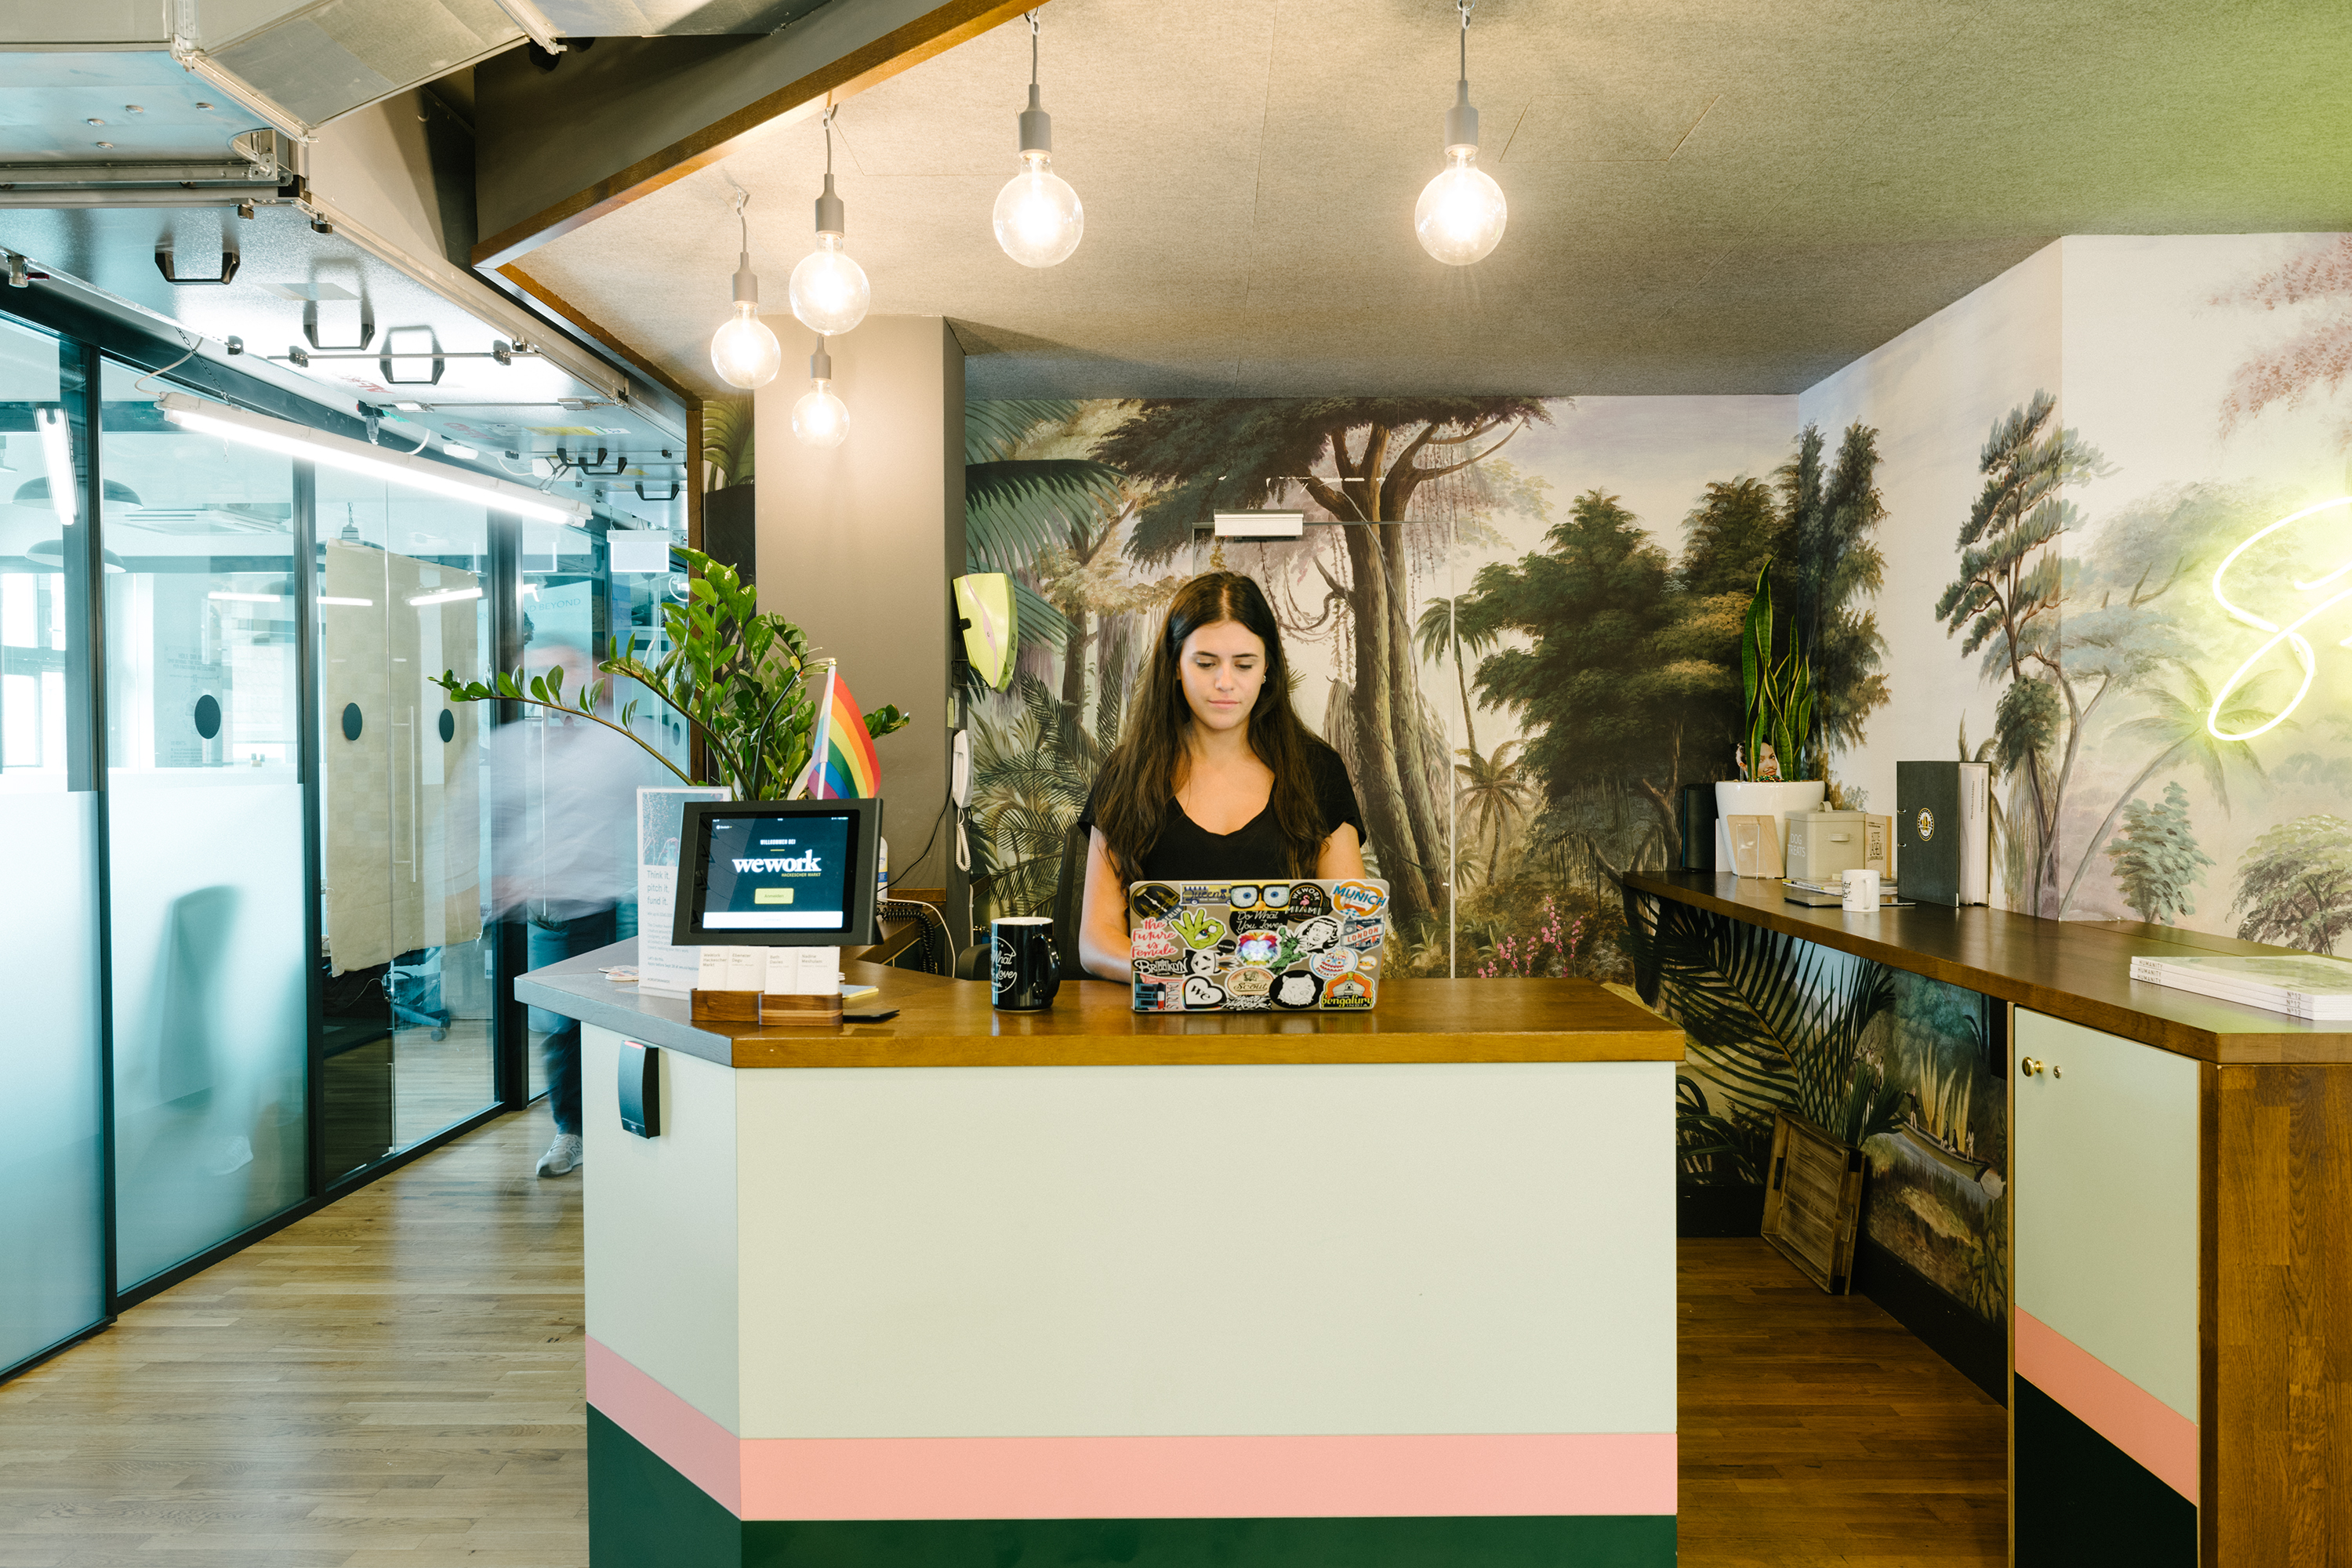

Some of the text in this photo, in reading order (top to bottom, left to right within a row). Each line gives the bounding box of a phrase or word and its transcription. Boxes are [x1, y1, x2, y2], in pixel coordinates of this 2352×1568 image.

[539, 597, 581, 611] BEYOND
[1791, 833, 1802, 844] DOG
[1788, 844, 1806, 858] TREATS
[731, 848, 822, 873] wework
[647, 870, 663, 880] Think
[648, 884, 662, 894] pitch
[1182, 889, 1226, 902] Queens
[1292, 887, 1321, 901] WEWORK
[1333, 885, 1386, 906] MUNICH
[648, 897, 660, 906] fund
[1237, 910, 1279, 920] Do What
[1284, 905, 1323, 916] MIAMI
[1143, 917, 1166, 930] the
[1236, 920, 1256, 935] You
[1132, 929, 1176, 942] Future
[1347, 927, 1378, 942] LONDON
[1131, 943, 1177, 958] Female
[2139, 960, 2164, 970] HUMANITY
[2137, 967, 2162, 977] HUMANITY
[2137, 974, 2161, 985] HUMANITY
[1233, 982, 1268, 991] Scout
[1167, 982, 1180, 1010] PARIS
